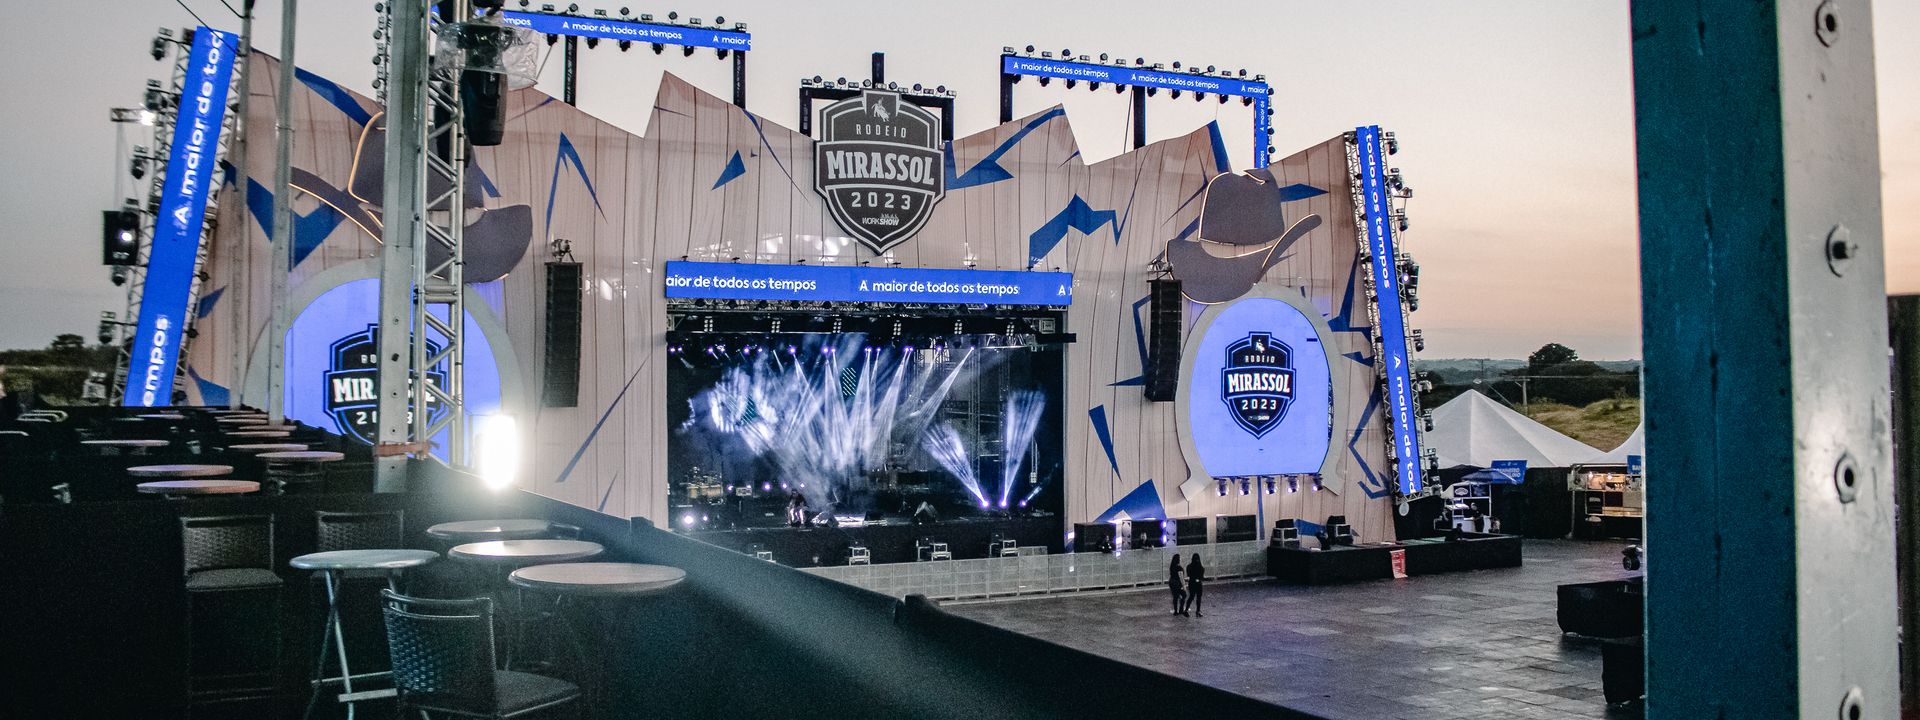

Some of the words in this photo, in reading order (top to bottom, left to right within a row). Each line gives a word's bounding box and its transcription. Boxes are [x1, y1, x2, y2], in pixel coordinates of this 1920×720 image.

[563, 21, 569, 29] A
[572, 22, 597, 32] maior
[600, 24, 611, 33] de
[612, 25, 637, 35] todos
[650, 29, 682, 40] tempos
[713, 34, 719, 42] A
[722, 36, 745, 45] maior
[1013, 61, 1019, 69] A
[1021, 62, 1041, 71] maior
[1042, 64, 1052, 72] de
[1053, 66, 1073, 75] todos
[1083, 68, 1109, 78] tempos
[1138, 75, 1158, 83] maior
[1159, 76, 1167, 84] de
[1168, 77, 1186, 86] todos
[1195, 80, 1219, 90] tempos
[1247, 86, 1266, 94] maior
[855, 123, 907, 139] RODEIO
[174, 206, 188, 225] A
[182, 117, 205, 195] maior
[196, 81, 213, 114] de
[1365, 131, 1376, 187] todos
[825, 150, 935, 186] MIRASSOL
[850, 191, 911, 210] 2023
[1373, 191, 1380, 213] os
[1375, 216, 1390, 289] tempos
[666, 275, 693, 287] aior
[694, 275, 711, 288] de
[713, 276, 750, 289] todos
[752, 279, 767, 289] os
[769, 278, 817, 292] tempos
[859, 280, 868, 291] A
[873, 279, 907, 292] maior
[910, 281, 925, 292] de
[927, 281, 959, 293] todos
[962, 284, 975, 294] os
[977, 283, 1019, 296] tempos
[1058, 284, 1066, 296] A
[1245, 354, 1276, 364] RODEIO
[1394, 354, 1401, 369] A
[1228, 373, 1290, 393] MIRASSOL
[1241, 398, 1277, 410] 2023
[1396, 376, 1409, 431] maior
[1404, 434, 1411, 458] de
